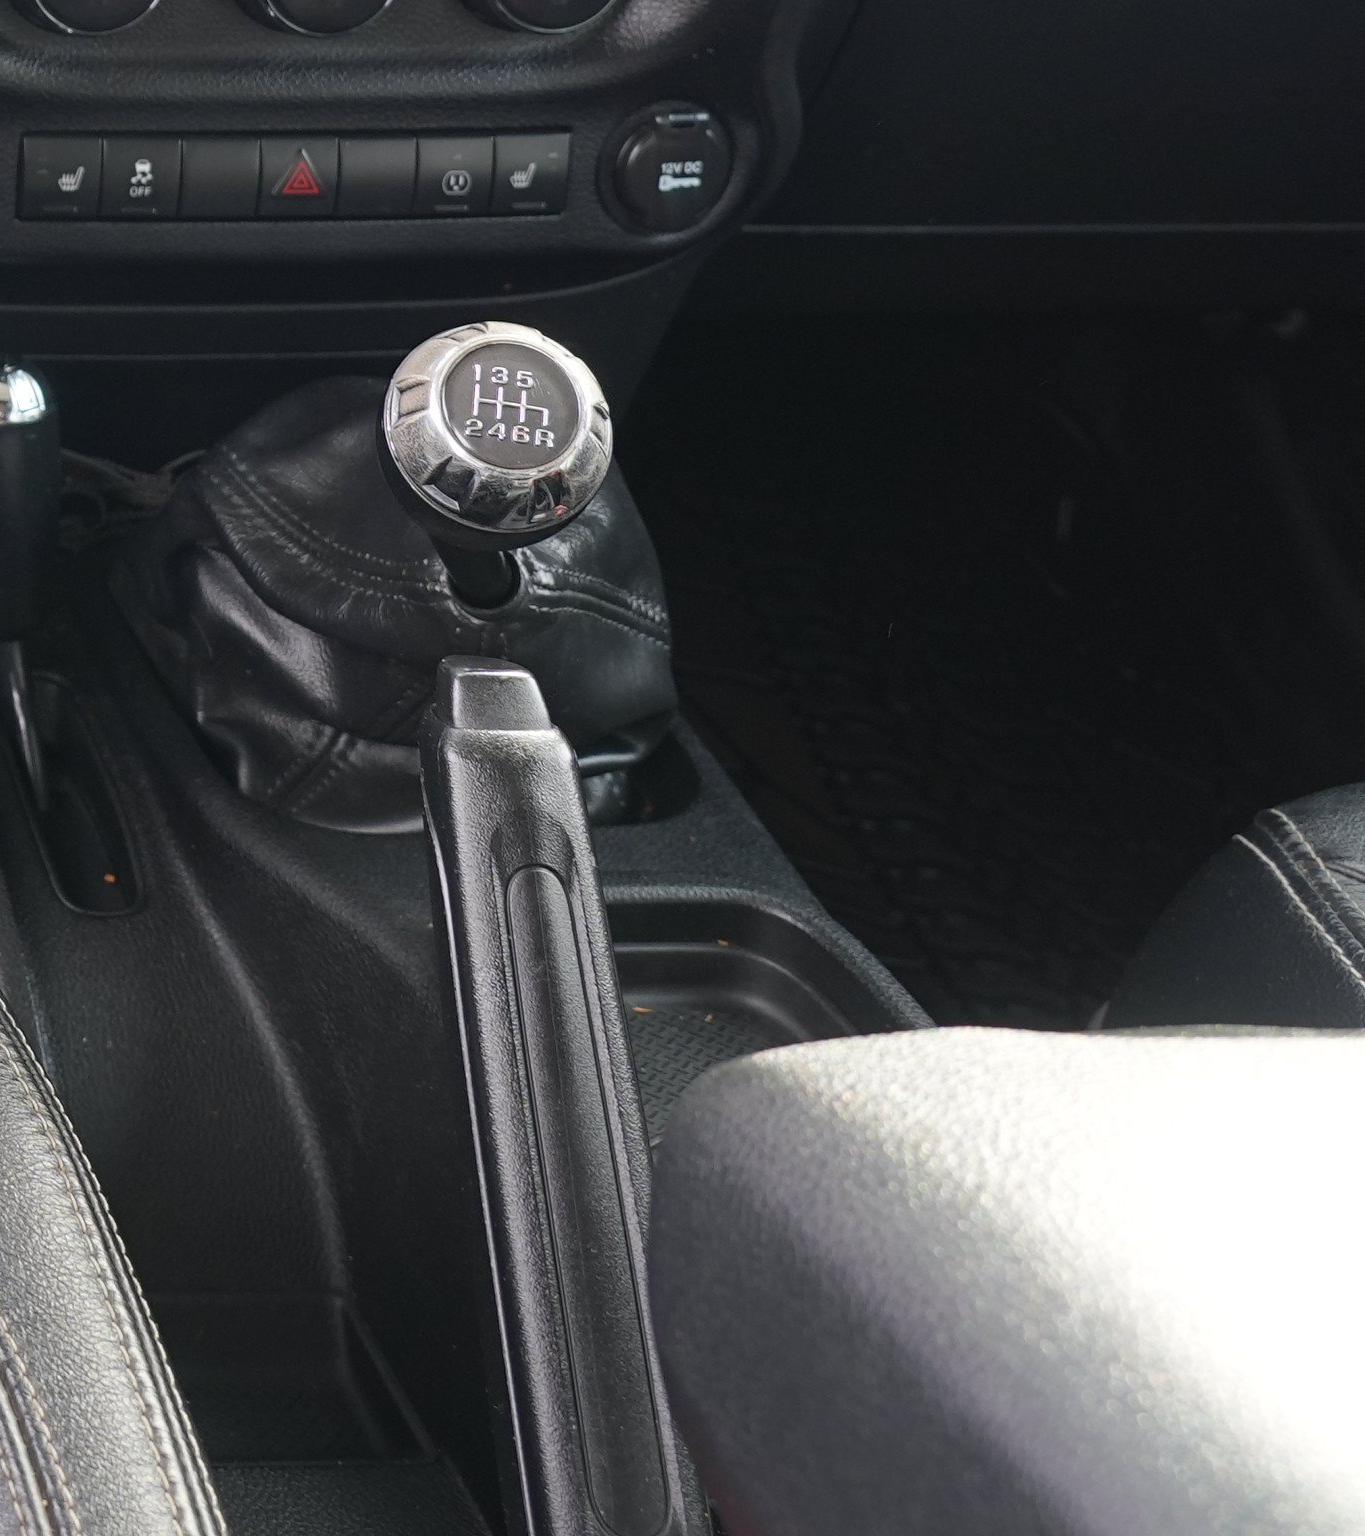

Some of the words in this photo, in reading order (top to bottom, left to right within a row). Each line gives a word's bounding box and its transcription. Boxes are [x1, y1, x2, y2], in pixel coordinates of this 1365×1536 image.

[661, 161, 683, 175] 12V
[684, 160, 704, 175] DC
[129, 185, 152, 198] OFF
[491, 366, 509, 385] 3
[516, 370, 534, 389] 5
[465, 418, 483, 437] 2
[487, 422, 506, 441] 4
[512, 425, 530, 444] 6
[535, 428, 555, 449] R
